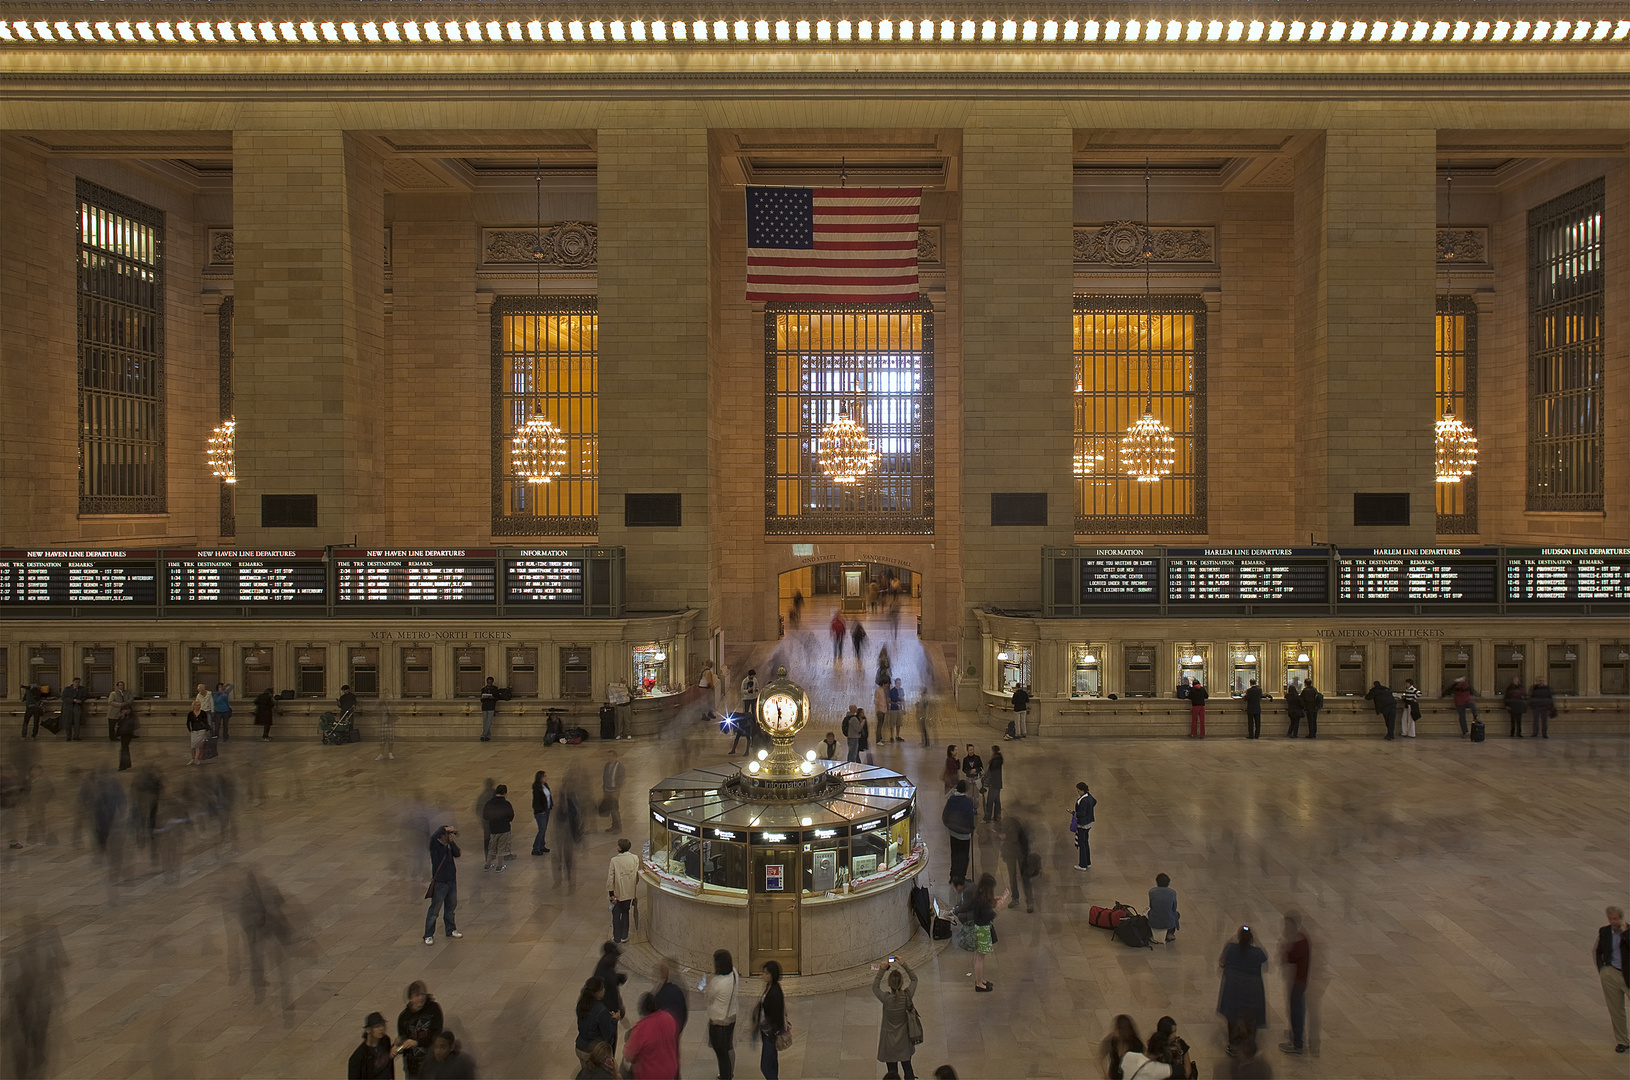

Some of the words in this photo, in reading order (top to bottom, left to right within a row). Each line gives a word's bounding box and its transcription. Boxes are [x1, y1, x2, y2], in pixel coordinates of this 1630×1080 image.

[1373, 548, 1402, 556] HARLEM
[1403, 548, 1419, 556] LINE
[1420, 548, 1462, 556] DEPARTURES
[371, 631, 393, 639] MTA
[398, 631, 468, 639] METRO-NORTH
[473, 631, 512, 639] TICKETS
[1316, 629, 1335, 637] MTA
[1338, 629, 1406, 637] METRO-NORTH
[1408, 629, 1445, 637] TICKETS
[764, 780, 807, 789] Information
